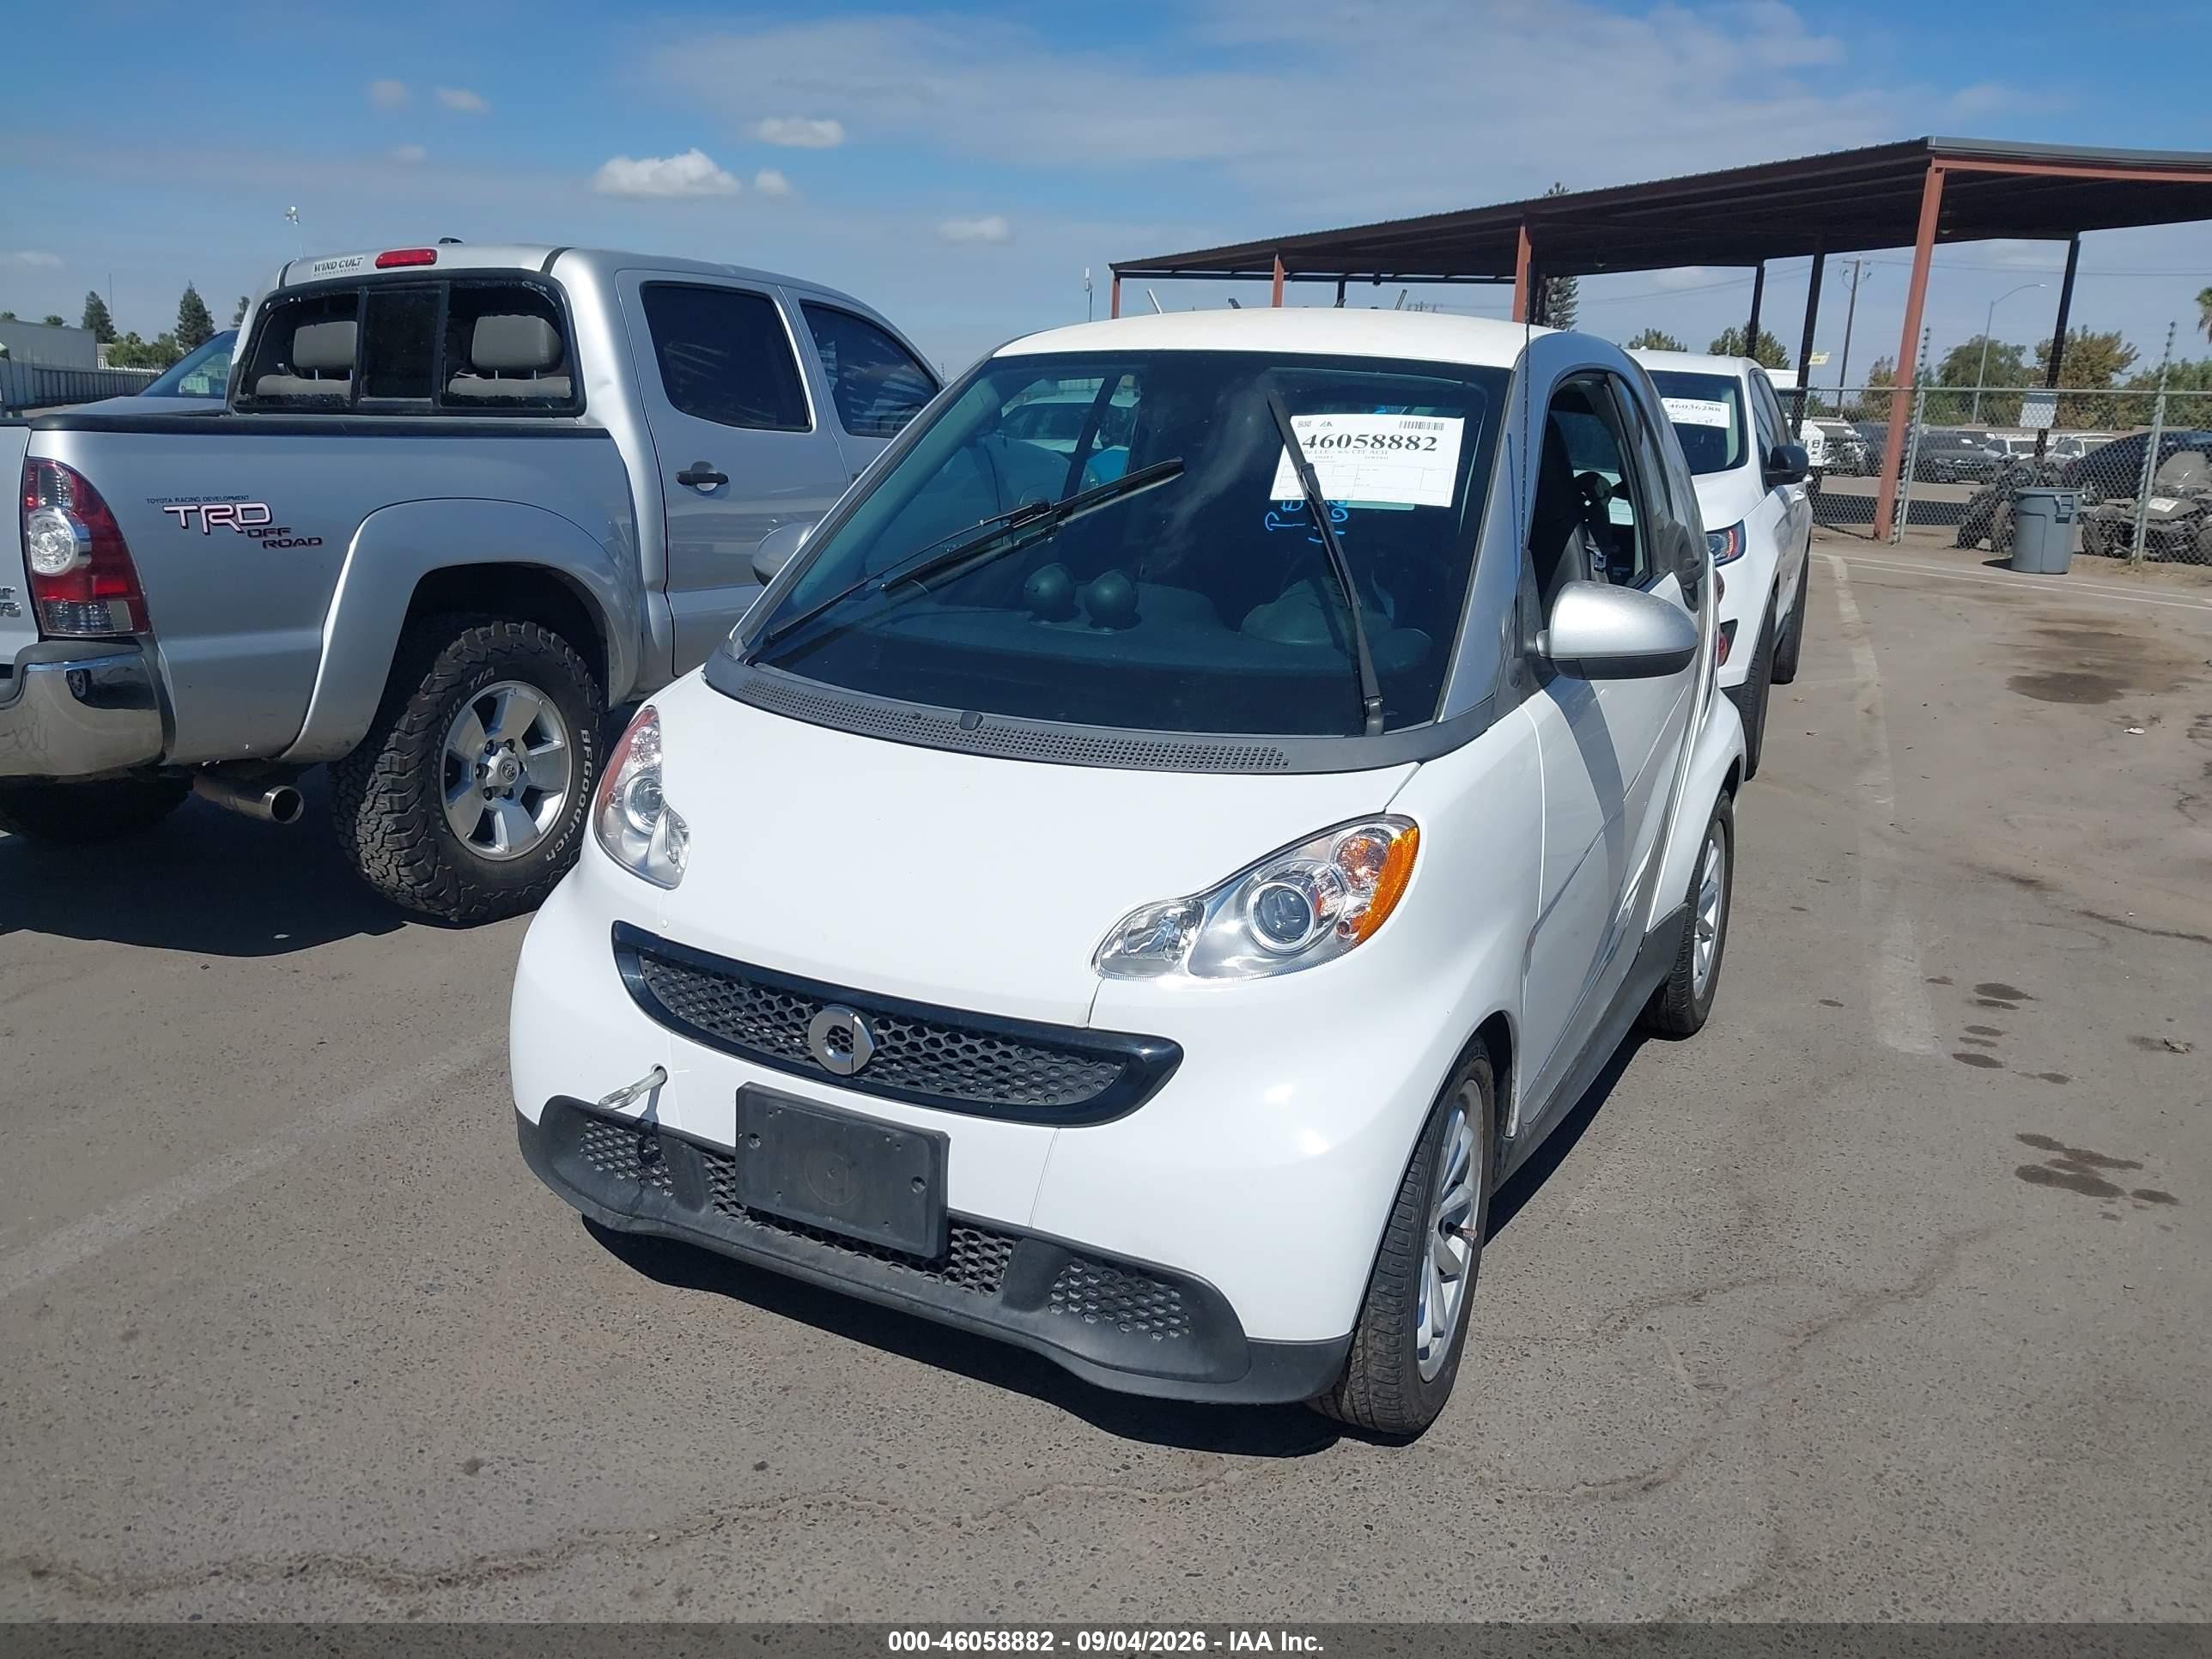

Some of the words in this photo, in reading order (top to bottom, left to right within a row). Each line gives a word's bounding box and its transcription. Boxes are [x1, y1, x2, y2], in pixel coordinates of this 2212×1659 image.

[338, 257, 363, 269] CULT
[1302, 433, 1437, 452] 46058882
[163, 502, 272, 535] TRD
[246, 526, 293, 538] OFF
[262, 537, 323, 550] ROAD
